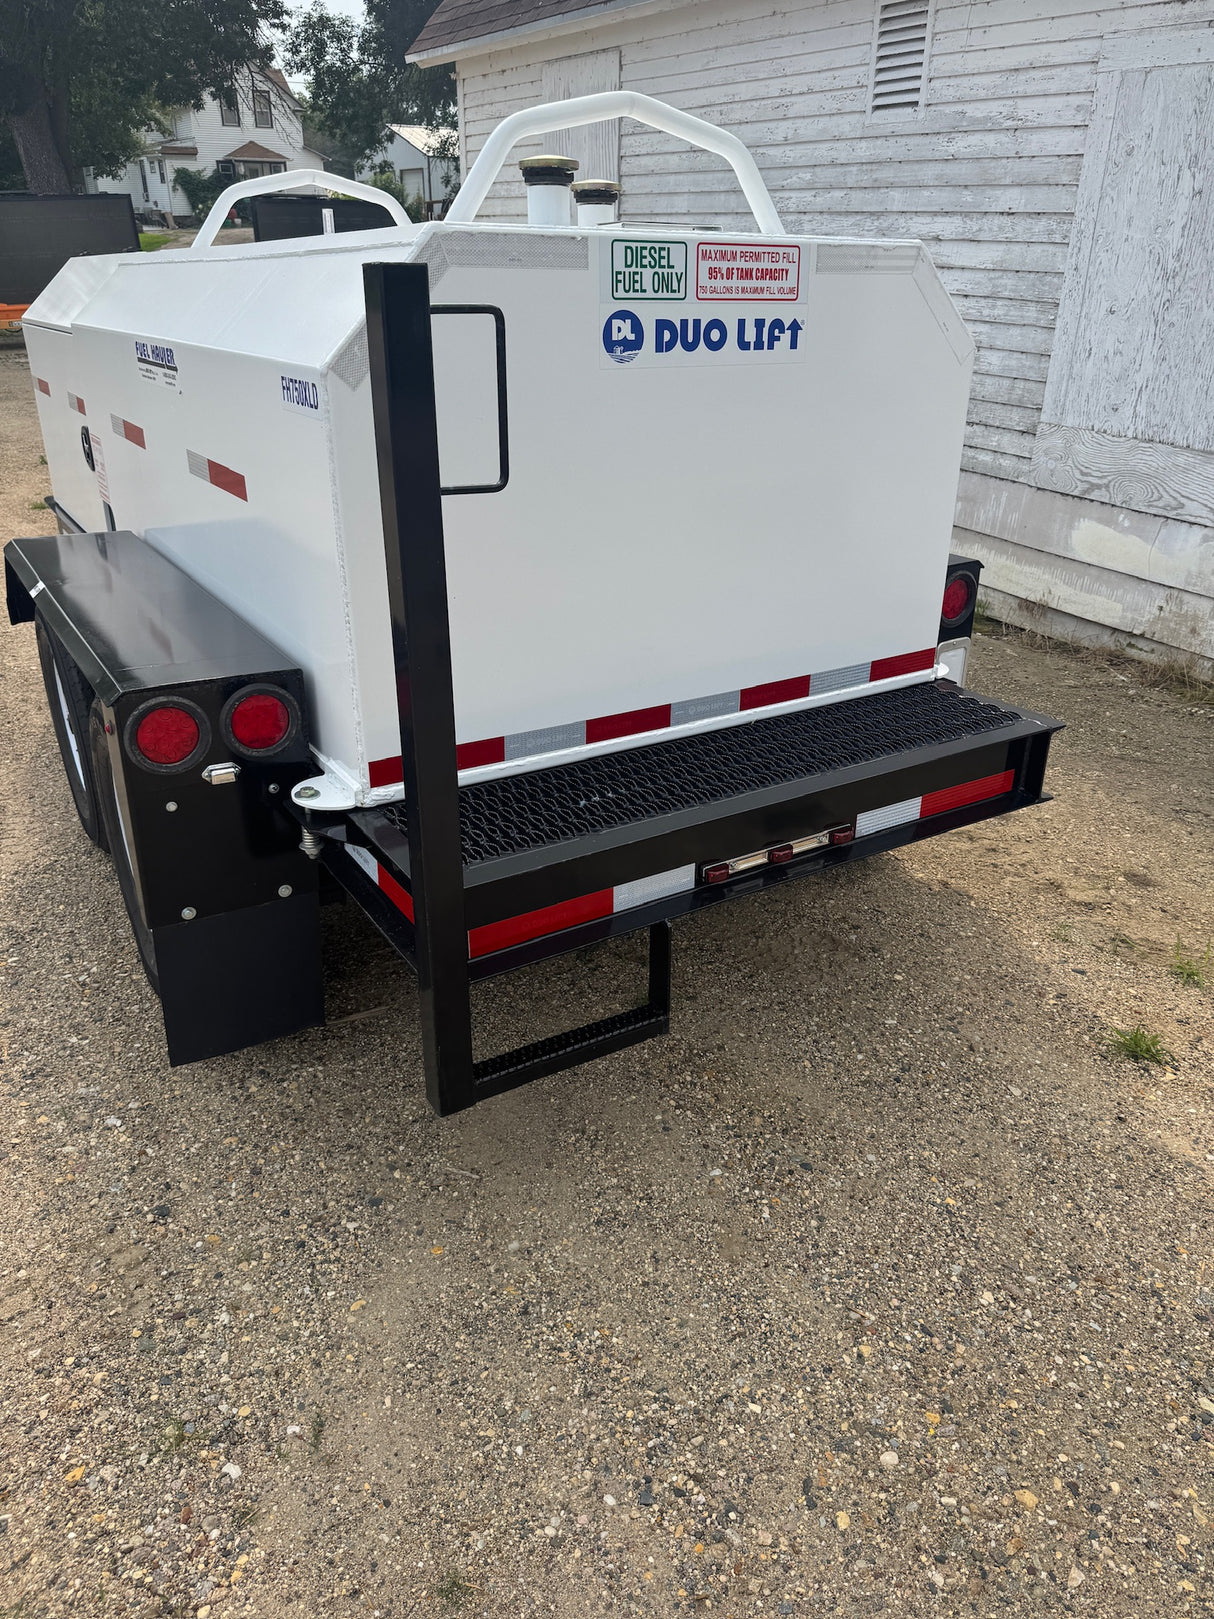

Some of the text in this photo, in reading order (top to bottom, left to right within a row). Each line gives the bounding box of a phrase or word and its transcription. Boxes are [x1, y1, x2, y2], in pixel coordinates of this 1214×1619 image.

[624, 245, 675, 270] DIESEL
[701, 248, 796, 264] MAXIMUM PERMITTED FILL
[615, 270, 684, 294] FUEL ONLY
[708, 266, 790, 282] 95% OF TANK CAPACITY
[699, 285, 797, 296] 750 GALLONS IS MAXIMUM FILL VOLUME
[611, 318, 636, 341] DL
[655, 318, 728, 353] DUO
[135, 341, 151, 359] FUEL
[280, 375, 319, 410] FH750XLD
